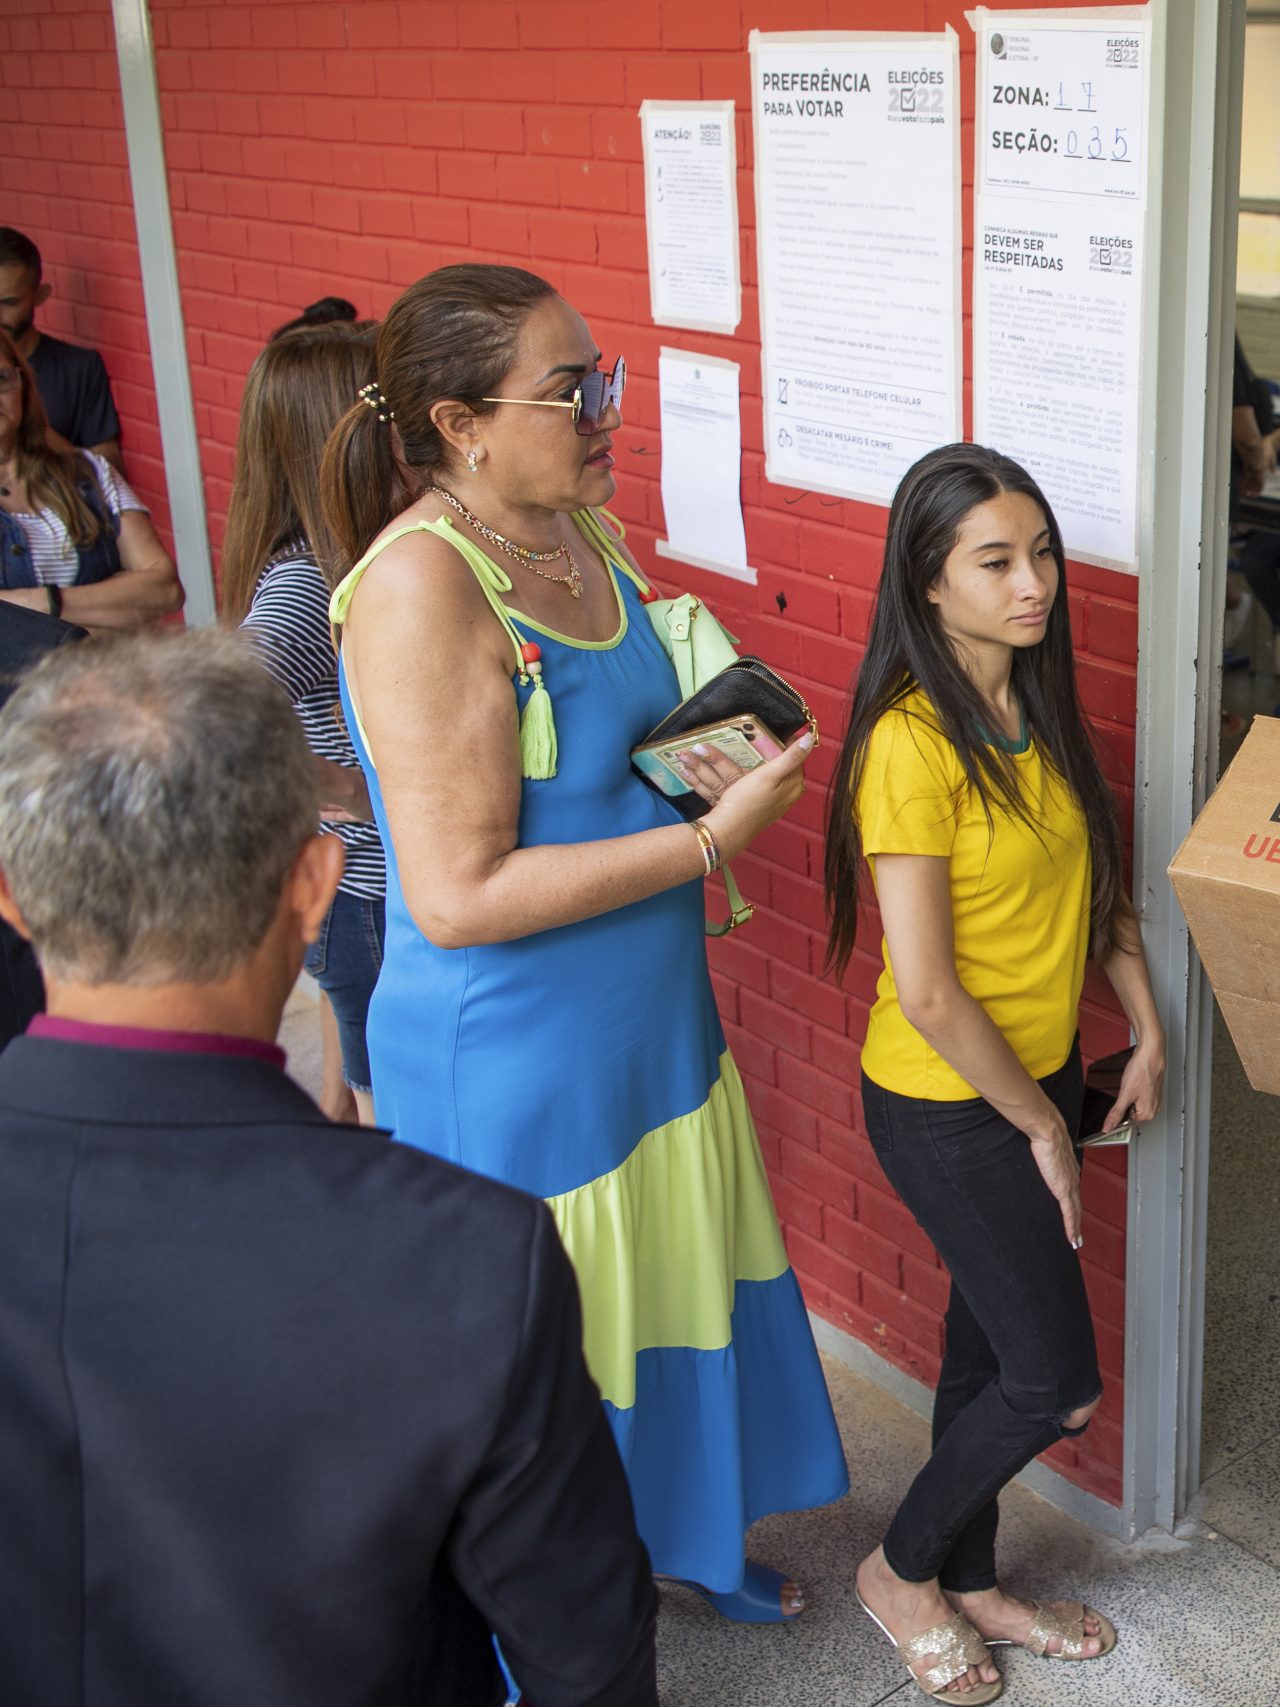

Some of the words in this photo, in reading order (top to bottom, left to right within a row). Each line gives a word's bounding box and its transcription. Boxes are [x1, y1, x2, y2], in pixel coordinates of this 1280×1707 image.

[1107, 38, 1139, 48] ELEIÇÕES
[763, 68, 871, 92] PREFERÊNCIA
[888, 68, 944, 87] ELEIÇÕES
[993, 85, 1049, 106] ZONA:
[764, 102, 792, 116] PARA
[796, 99, 843, 117] VOTAR
[654, 128, 691, 140] ATENÇÃO!
[992, 128, 1058, 154] SEÇÃO:
[984, 234, 1020, 249] DEVEM
[1023, 238, 1044, 251] SER
[1090, 236, 1133, 249] ELEIÇÕES
[984, 250, 1063, 271] RESPEITADAS
[826, 383, 850, 395] PORTAR
[853, 388, 888, 401] TELEFONE
[890, 393, 922, 406] CELULAR
[796, 425, 833, 439] DESACATAR
[835, 431, 864, 446] MESÁRIO
[865, 437, 869, 446] É
